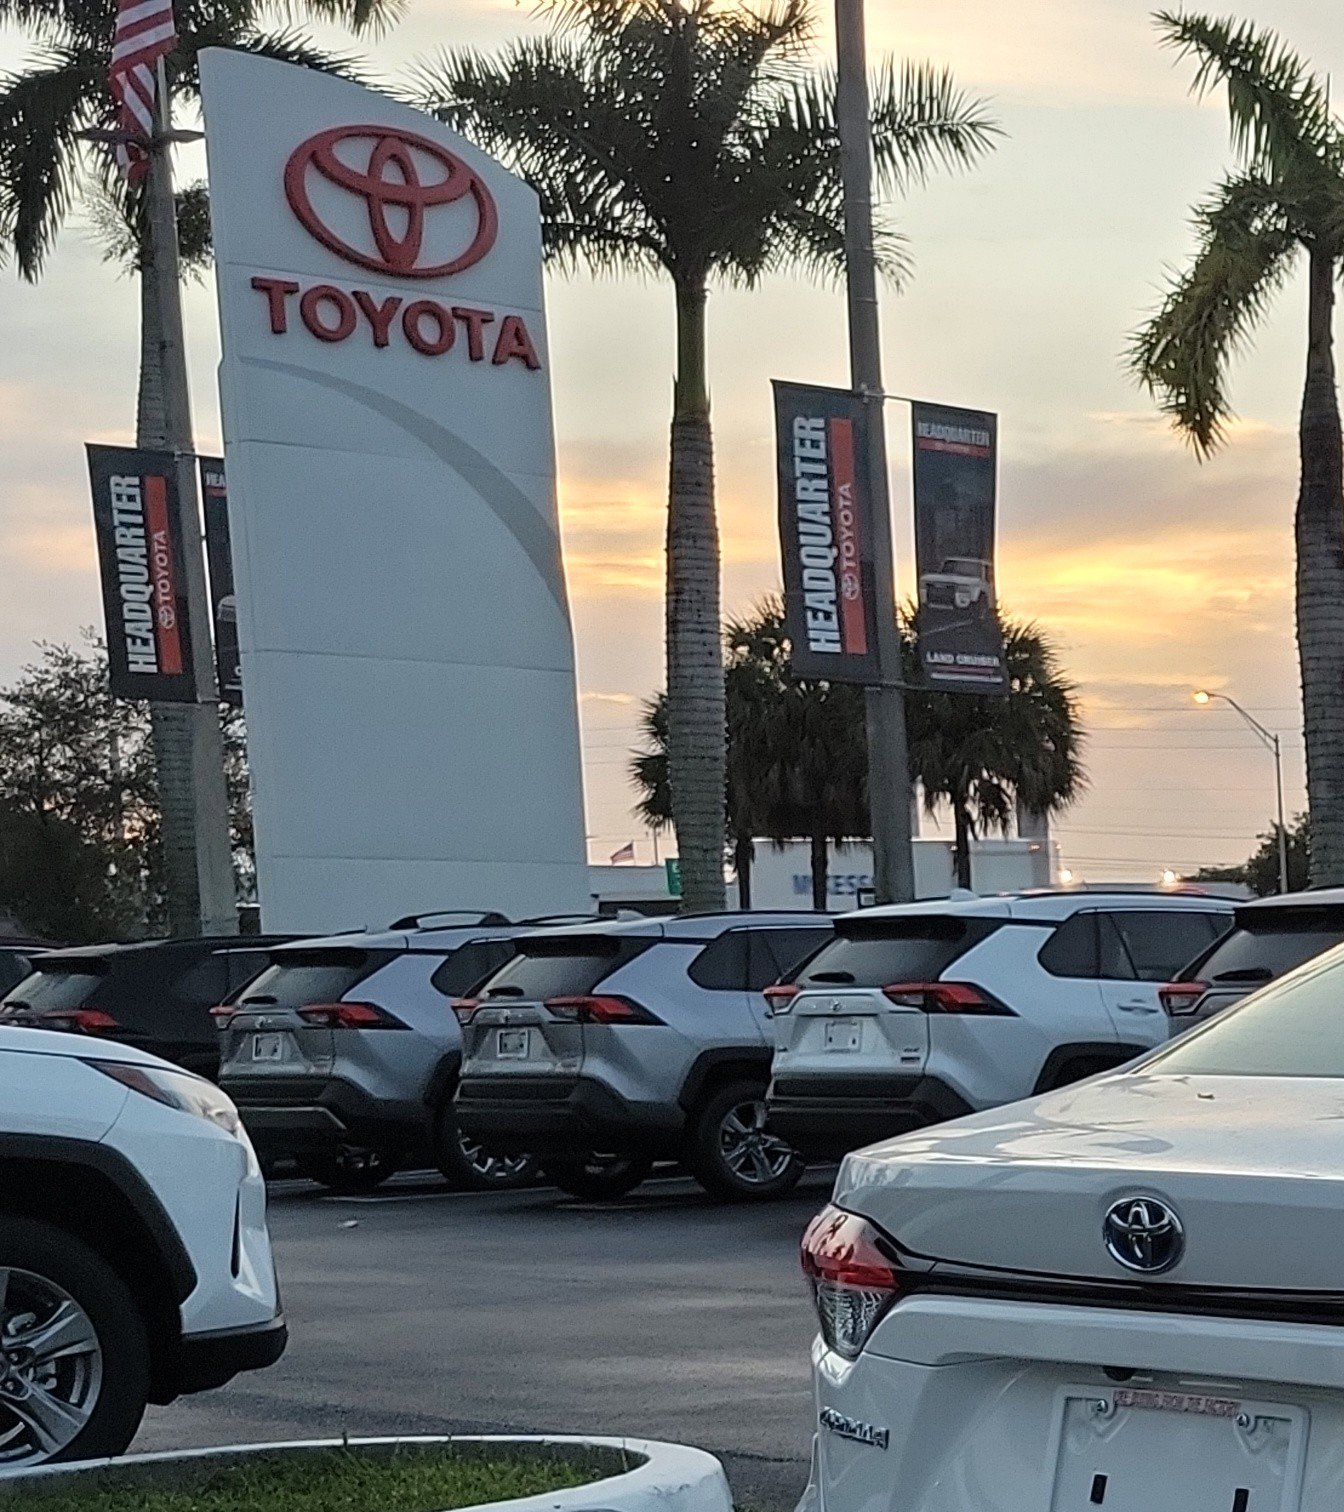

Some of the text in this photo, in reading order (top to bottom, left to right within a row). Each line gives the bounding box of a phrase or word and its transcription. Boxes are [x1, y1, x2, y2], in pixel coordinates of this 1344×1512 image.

[250, 276, 542, 371] TOYOTA
[152, 530, 173, 602] TOYOTA
[793, 416, 842, 653] HEADQUARTER
[839, 483, 857, 569] TOYOTA
[109, 474, 158, 673] HEADQUARTER
[925, 651, 955, 664] LAND
